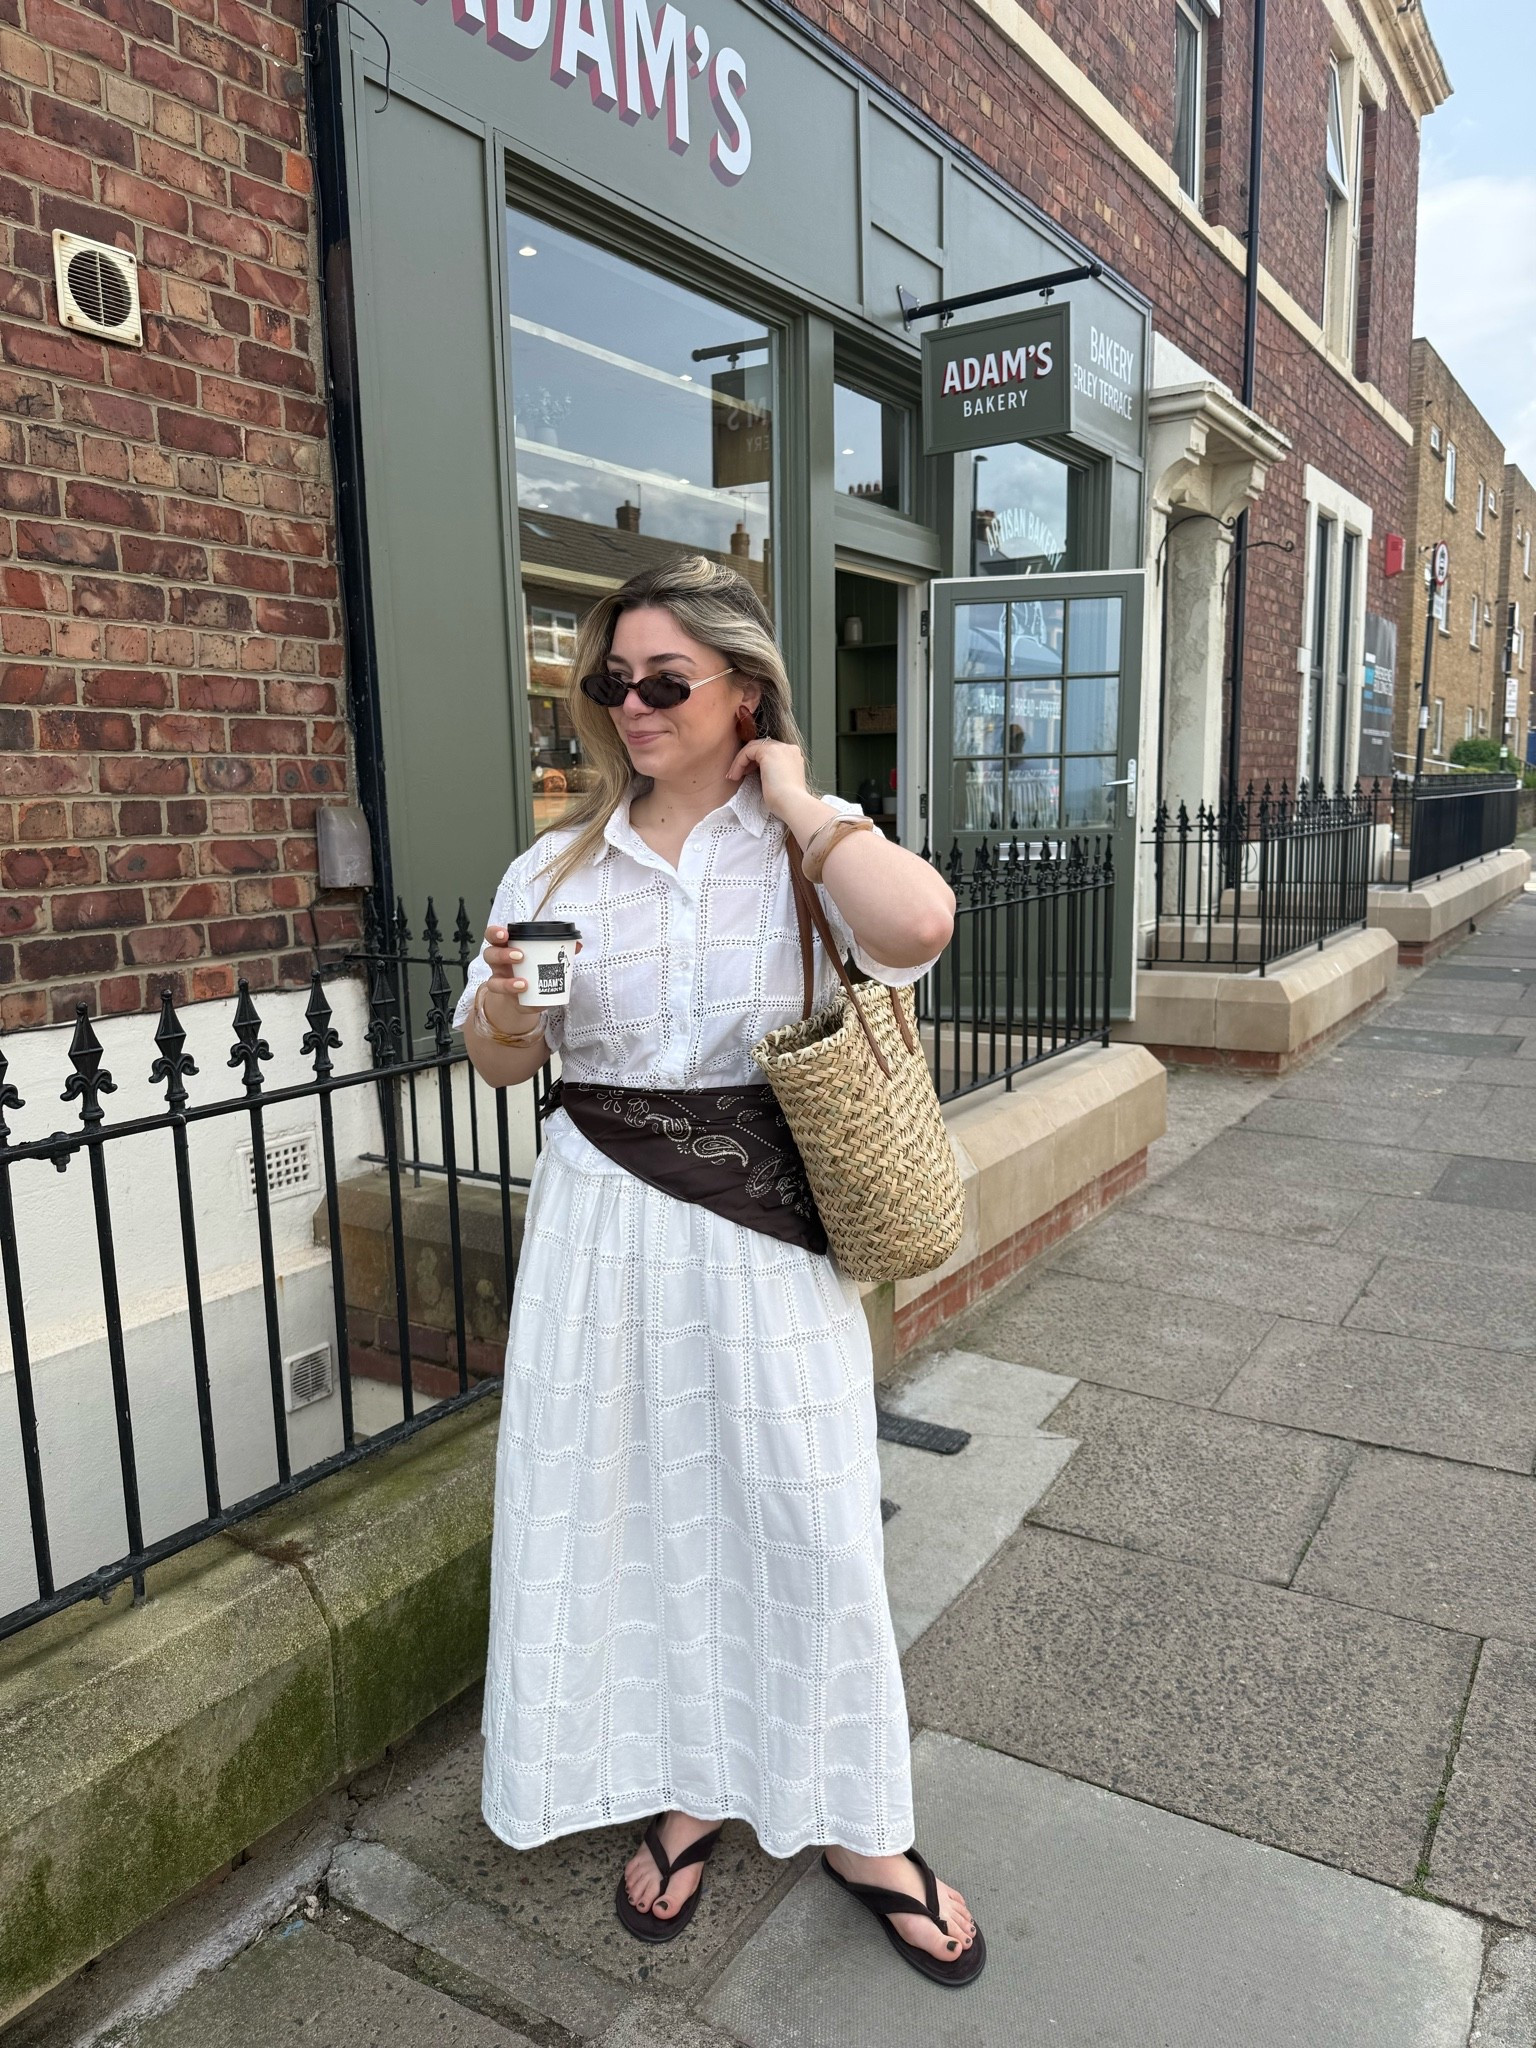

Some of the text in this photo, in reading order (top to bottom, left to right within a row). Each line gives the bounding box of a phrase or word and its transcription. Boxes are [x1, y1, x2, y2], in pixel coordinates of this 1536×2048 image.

[452, 0, 753, 187] AM'S
[941, 341, 1054, 398] ADAM'S
[1090, 325, 1135, 386] BAKERY
[963, 389, 1028, 418] BAKERY
[1099, 378, 1133, 421] TERRACE
[985, 507, 1063, 572] ARTISAN BAKERY
[538, 978, 564, 988] ADAM'S
